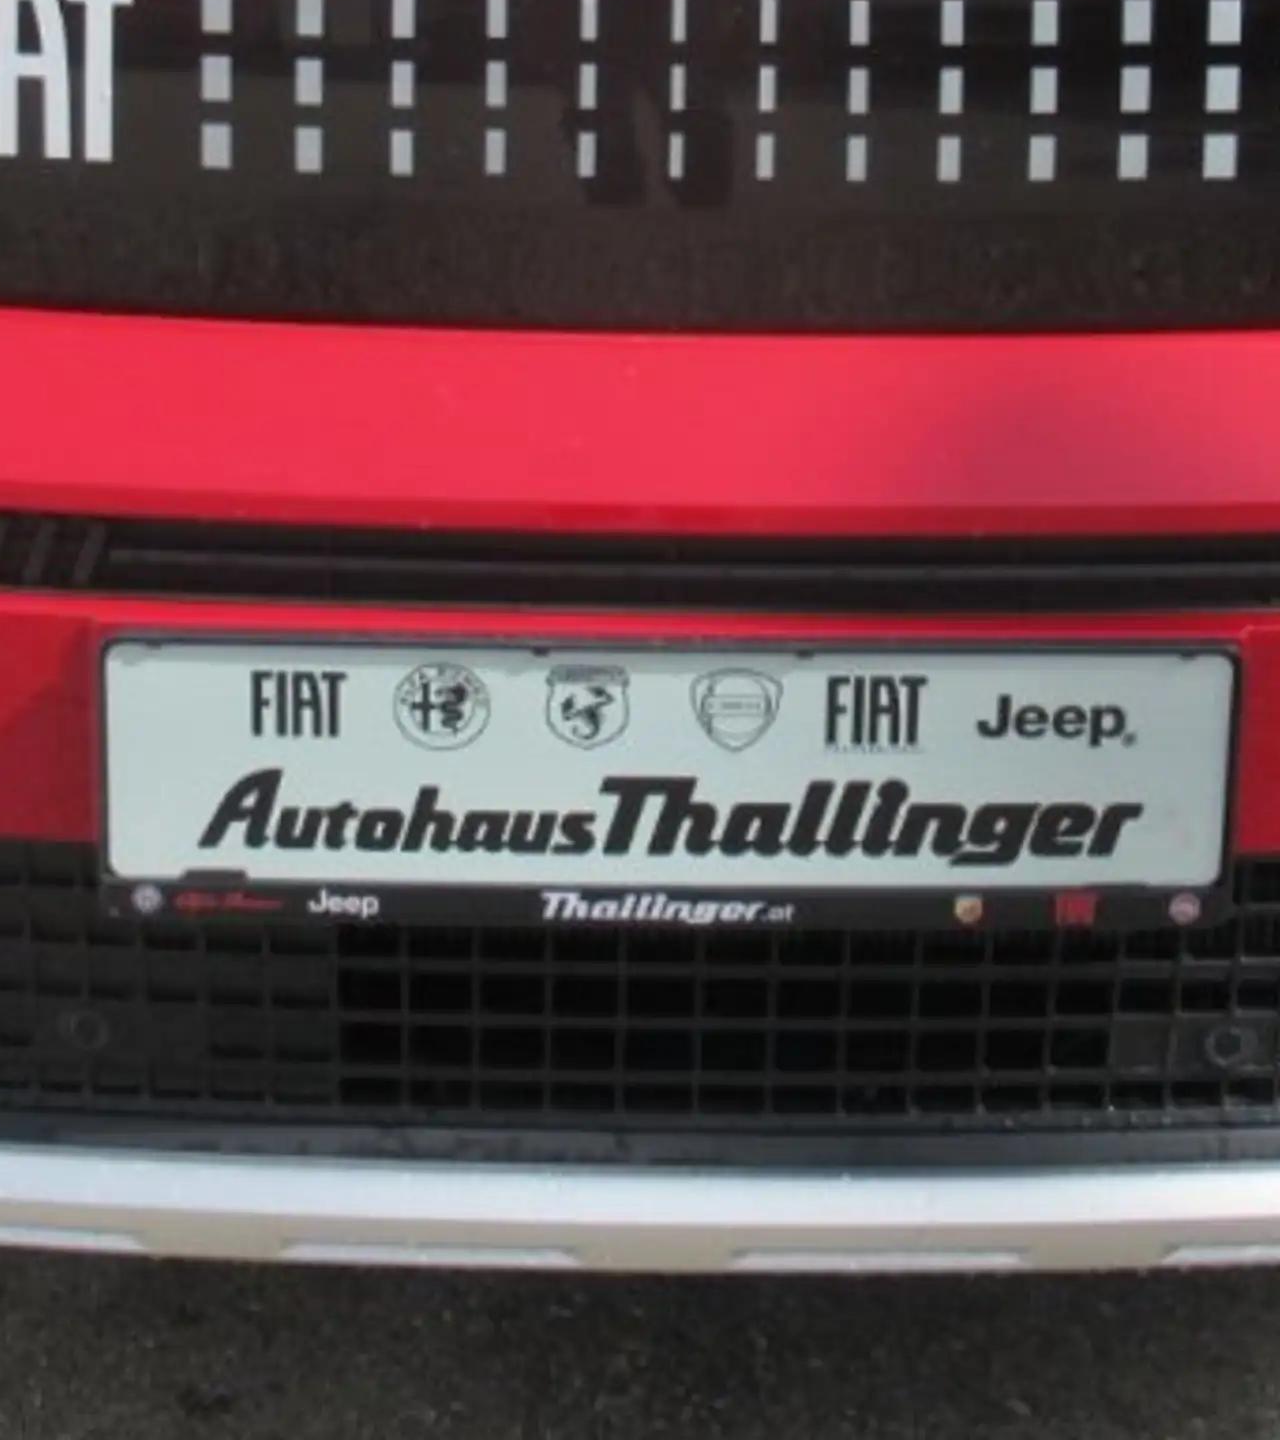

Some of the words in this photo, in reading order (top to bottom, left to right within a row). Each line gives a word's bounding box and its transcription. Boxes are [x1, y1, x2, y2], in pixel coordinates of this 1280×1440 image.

[250, 670, 348, 738] FIAT
[825, 675, 928, 744] FIAT
[976, 693, 1128, 748] Jeep
[307, 887, 380, 919] Jeep
